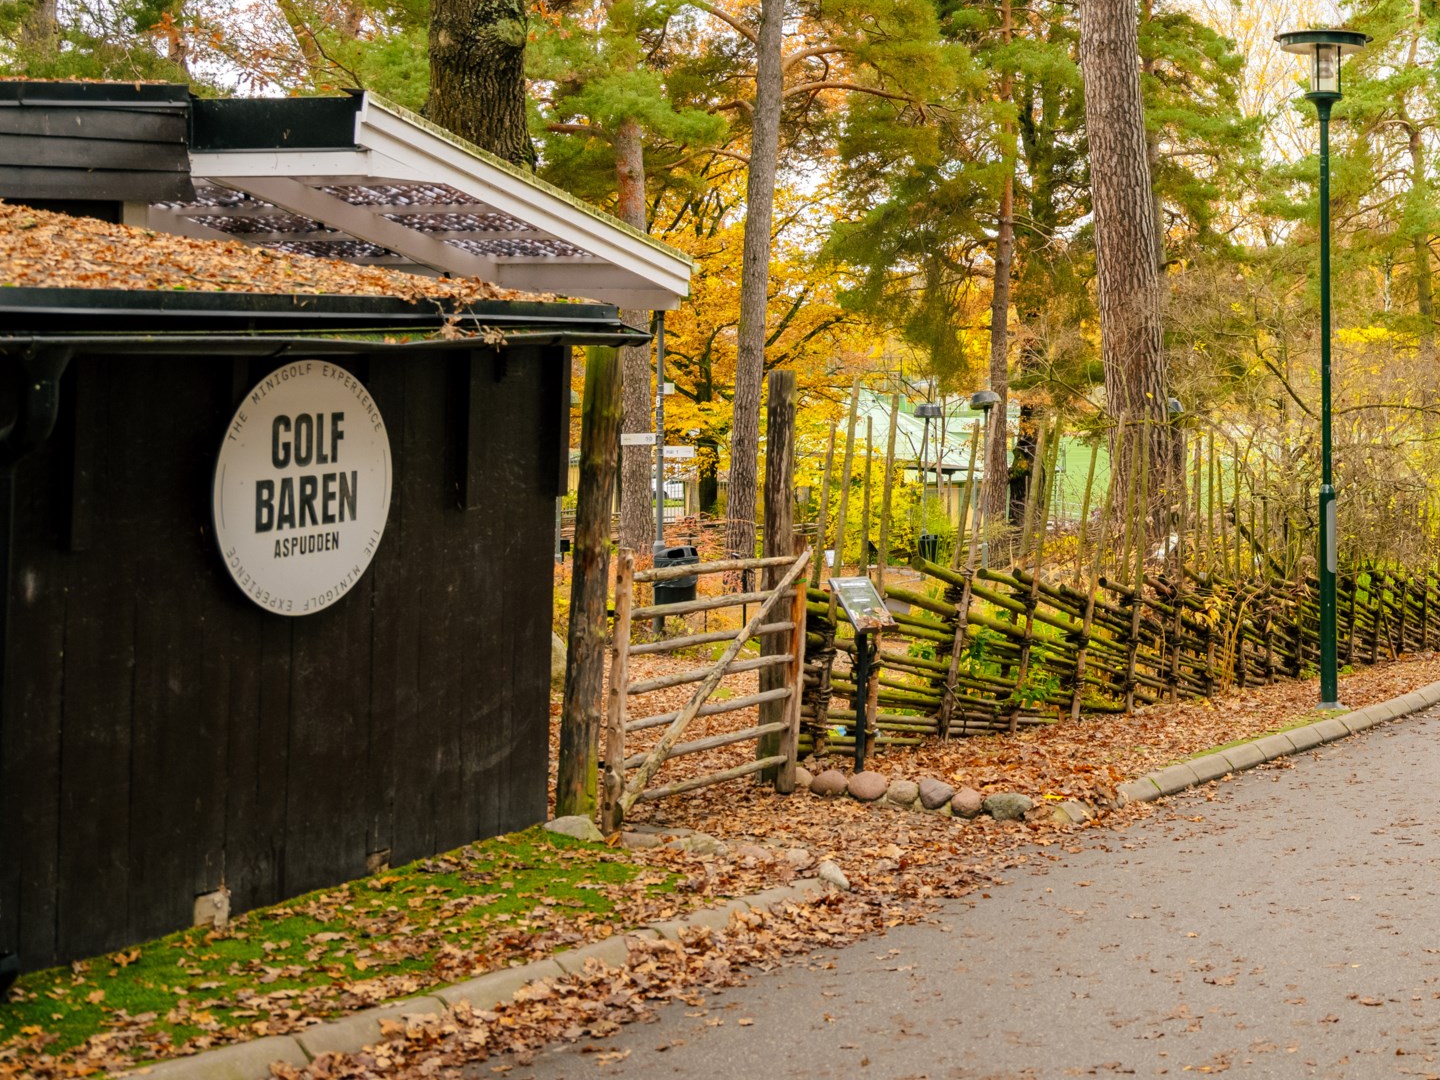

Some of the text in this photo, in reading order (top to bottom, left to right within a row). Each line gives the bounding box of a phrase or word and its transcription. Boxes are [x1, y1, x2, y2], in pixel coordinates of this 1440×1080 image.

[228, 363, 382, 441] THE MINIGOLF EXPERIENCE
[272, 411, 345, 469] GOLF
[255, 470, 358, 534] BAREN
[226, 529, 380, 612] THE MINIGOLF EXPERIENCE
[274, 531, 339, 559] ASPUDDEN
